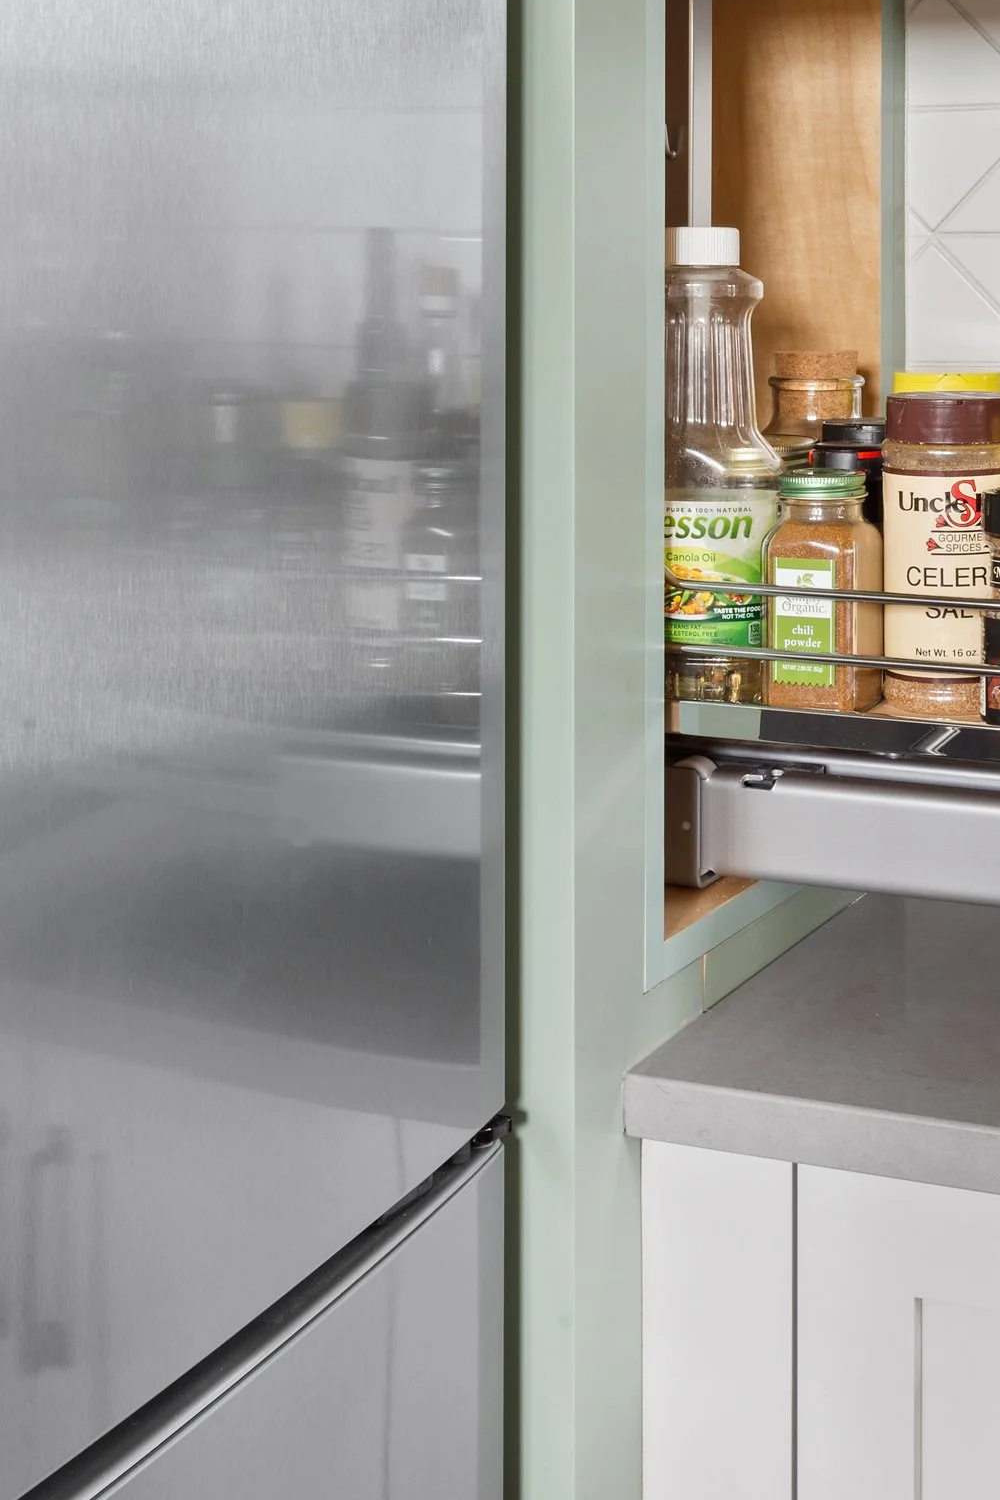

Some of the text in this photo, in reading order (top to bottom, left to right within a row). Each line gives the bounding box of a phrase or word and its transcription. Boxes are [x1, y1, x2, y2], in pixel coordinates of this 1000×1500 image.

[898, 490, 968, 513] Uncle
[945, 543, 982, 552] SPICES
[666, 552, 716, 562] Canola Oil
[782, 600, 825, 614] Organic
[792, 625, 814, 636] chili
[784, 637, 822, 649] powder
[915, 647, 931, 657] Net
[952, 648, 964, 657] 16
[966, 649, 980, 657] oz.
